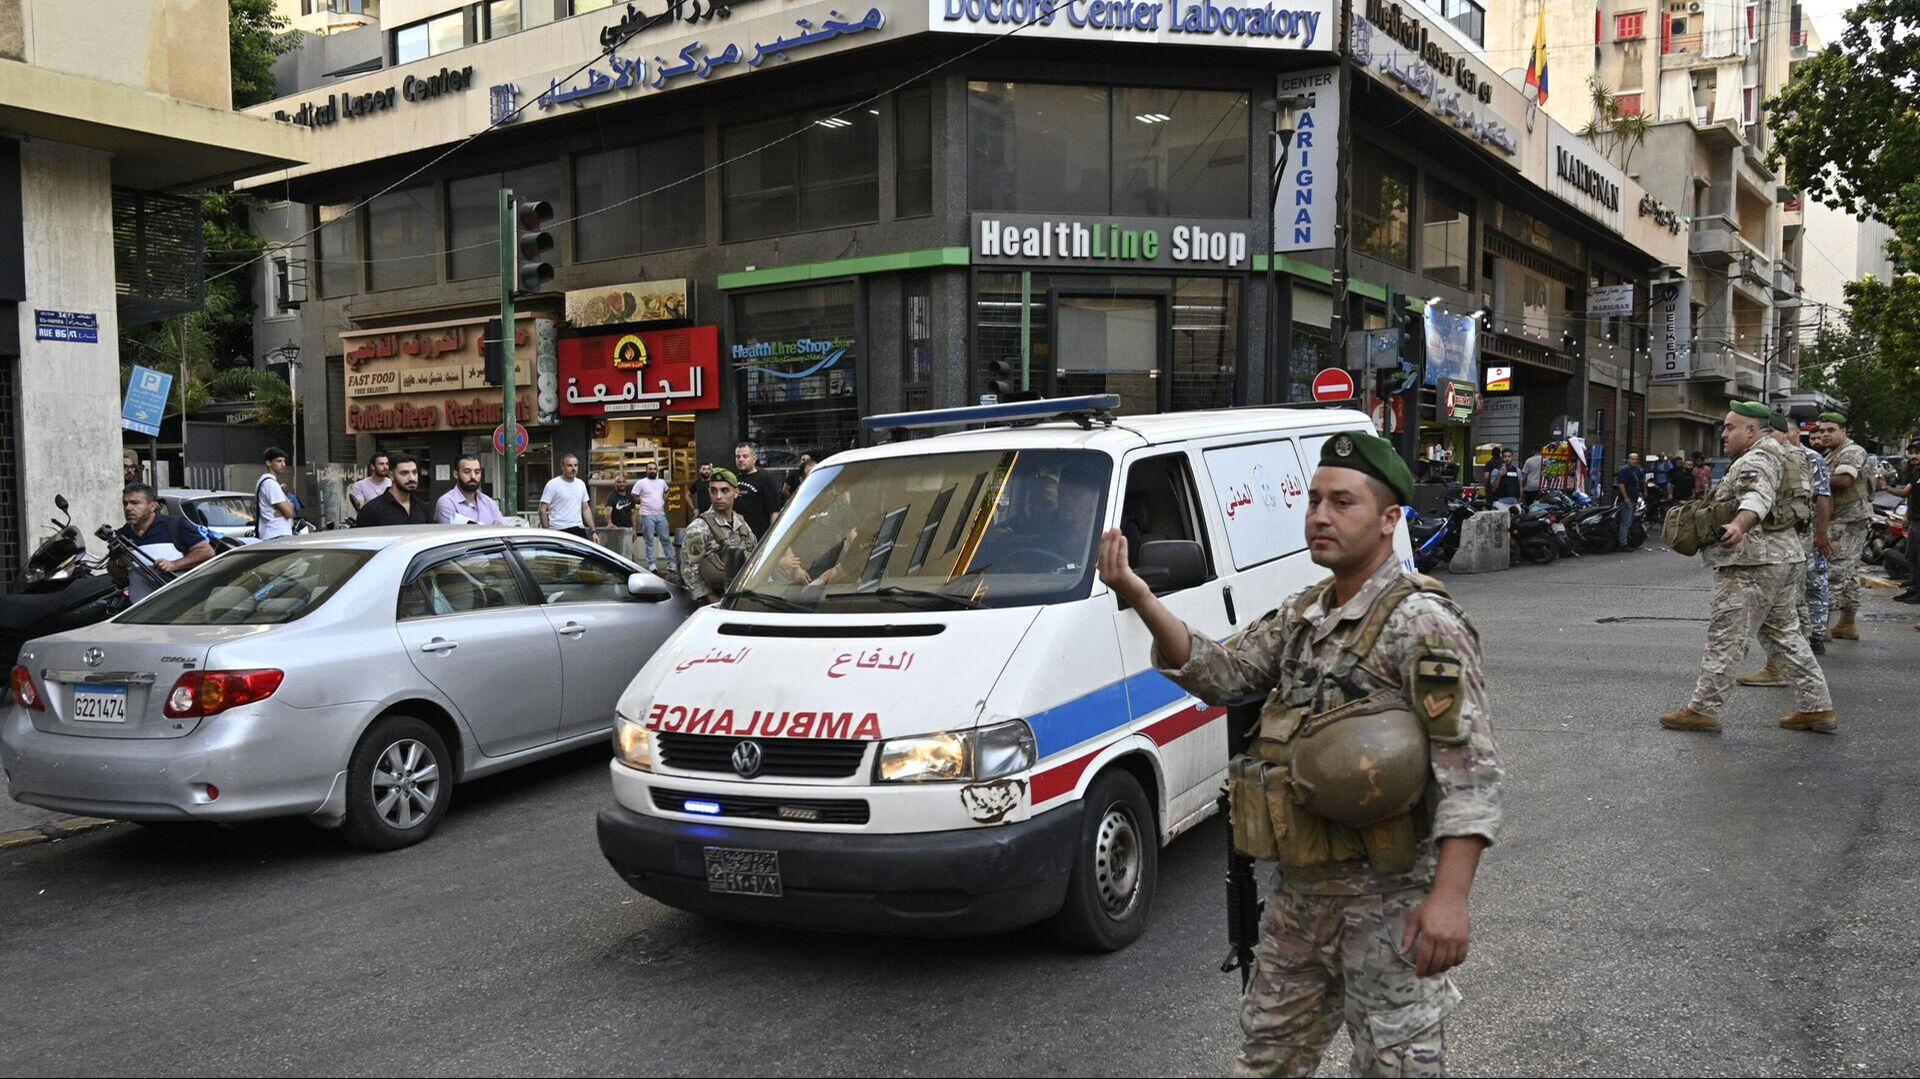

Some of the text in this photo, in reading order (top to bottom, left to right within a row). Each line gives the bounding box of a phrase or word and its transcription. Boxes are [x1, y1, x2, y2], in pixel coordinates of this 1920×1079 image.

[748, 7, 886, 67] مختبر
[943, 0, 1321, 48] Doctors Center Laboratory
[651, 41, 743, 89] مركز
[1281, 72, 1332, 91] CENTER
[341, 87, 396, 119] Laser
[402, 66, 473, 103] Center
[1556, 145, 1619, 213] MARIGNAN
[981, 219, 1247, 267] HealthLine Shop
[38, 328, 53, 338] RUE
[1665, 303, 1676, 371] WEEKEND
[348, 373, 370, 387] FAST
[371, 371, 395, 386] FOOD
[366, 386, 389, 395] DELIVERY
[566, 366, 702, 406] الجامعة
[349, 404, 394, 430] Golden
[394, 402, 438, 429] Sheep
[1226, 473, 1304, 521] الدفاع المدني
[675, 646, 916, 679] الدفاع المدني
[75, 698, 124, 718] G221474
